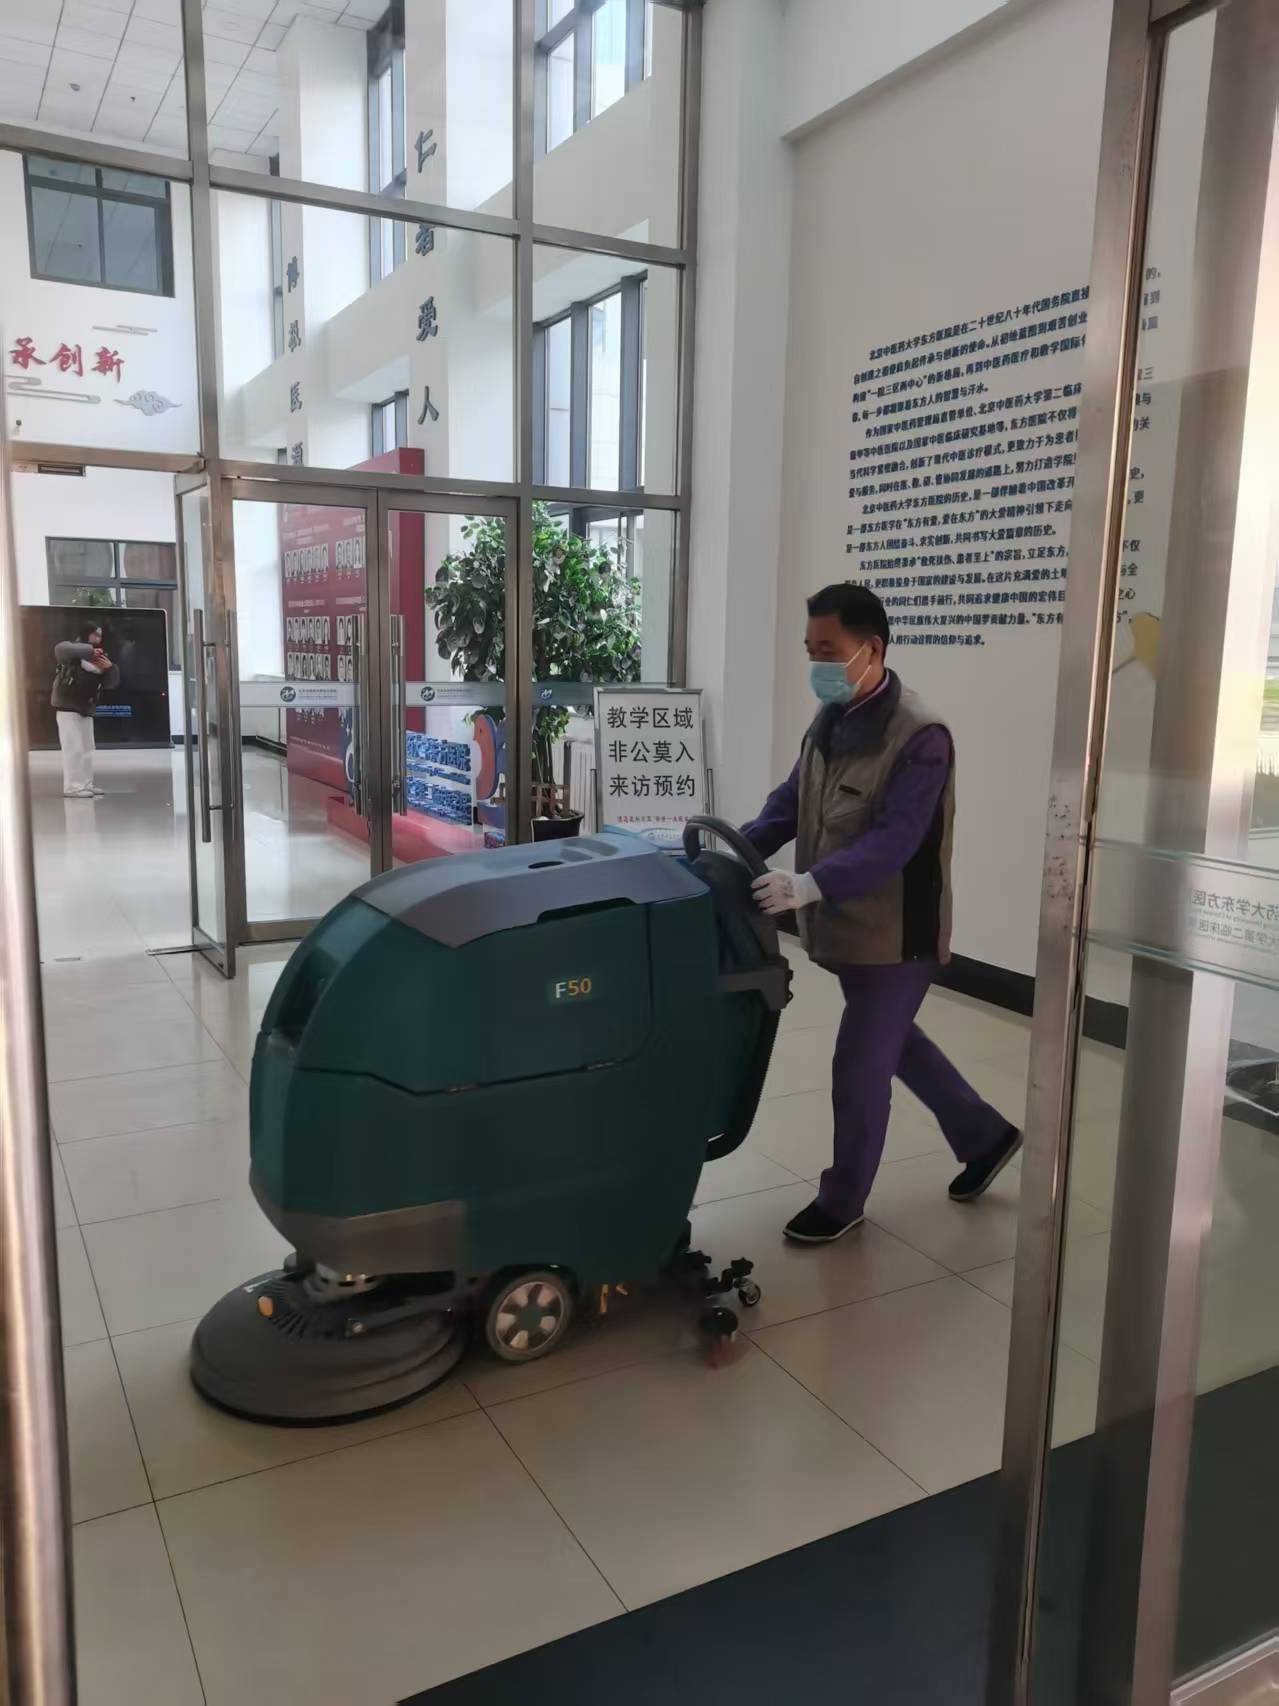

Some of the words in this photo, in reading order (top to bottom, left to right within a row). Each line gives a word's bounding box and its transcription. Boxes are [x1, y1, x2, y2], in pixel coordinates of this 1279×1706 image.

[606, 706, 695, 729] 教学区域
[608, 740, 695, 763] 非公莫入
[608, 774, 695, 798] 来访预约
[555, 978, 592, 998] F50
